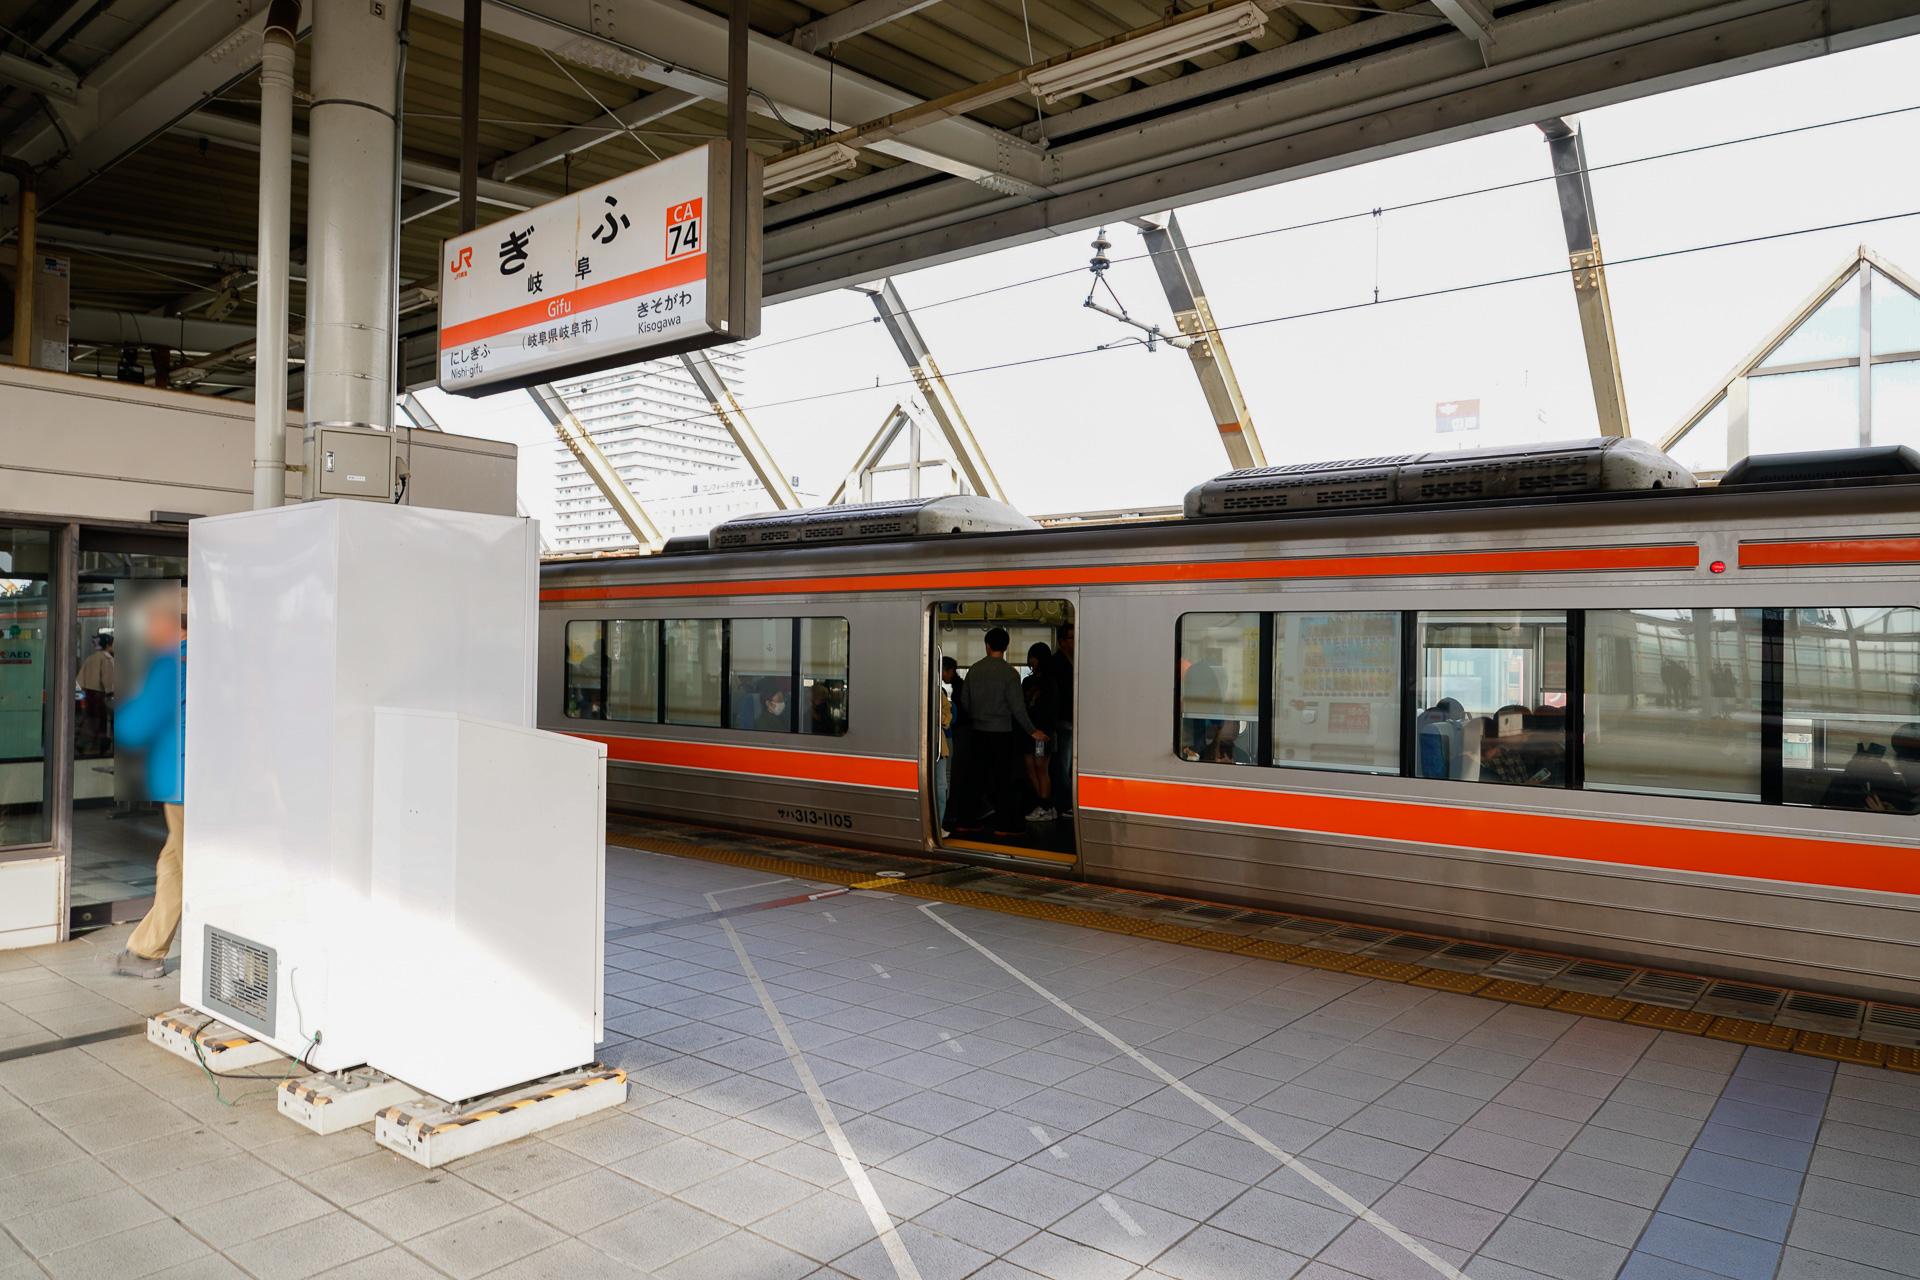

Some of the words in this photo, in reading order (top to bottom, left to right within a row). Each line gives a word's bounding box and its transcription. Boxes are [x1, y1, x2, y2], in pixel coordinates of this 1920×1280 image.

[375, 3, 382, 15] 5
[673, 202, 694, 222] CA
[669, 220, 698, 255] 74
[450, 246, 473, 273] JR
[547, 298, 571, 317] Gifu
[637, 290, 692, 318] きそがわ
[638, 315, 681, 334] Kisogawa
[450, 343, 491, 366] にしぎふ
[451, 363, 483, 379] Nishi-gifu
